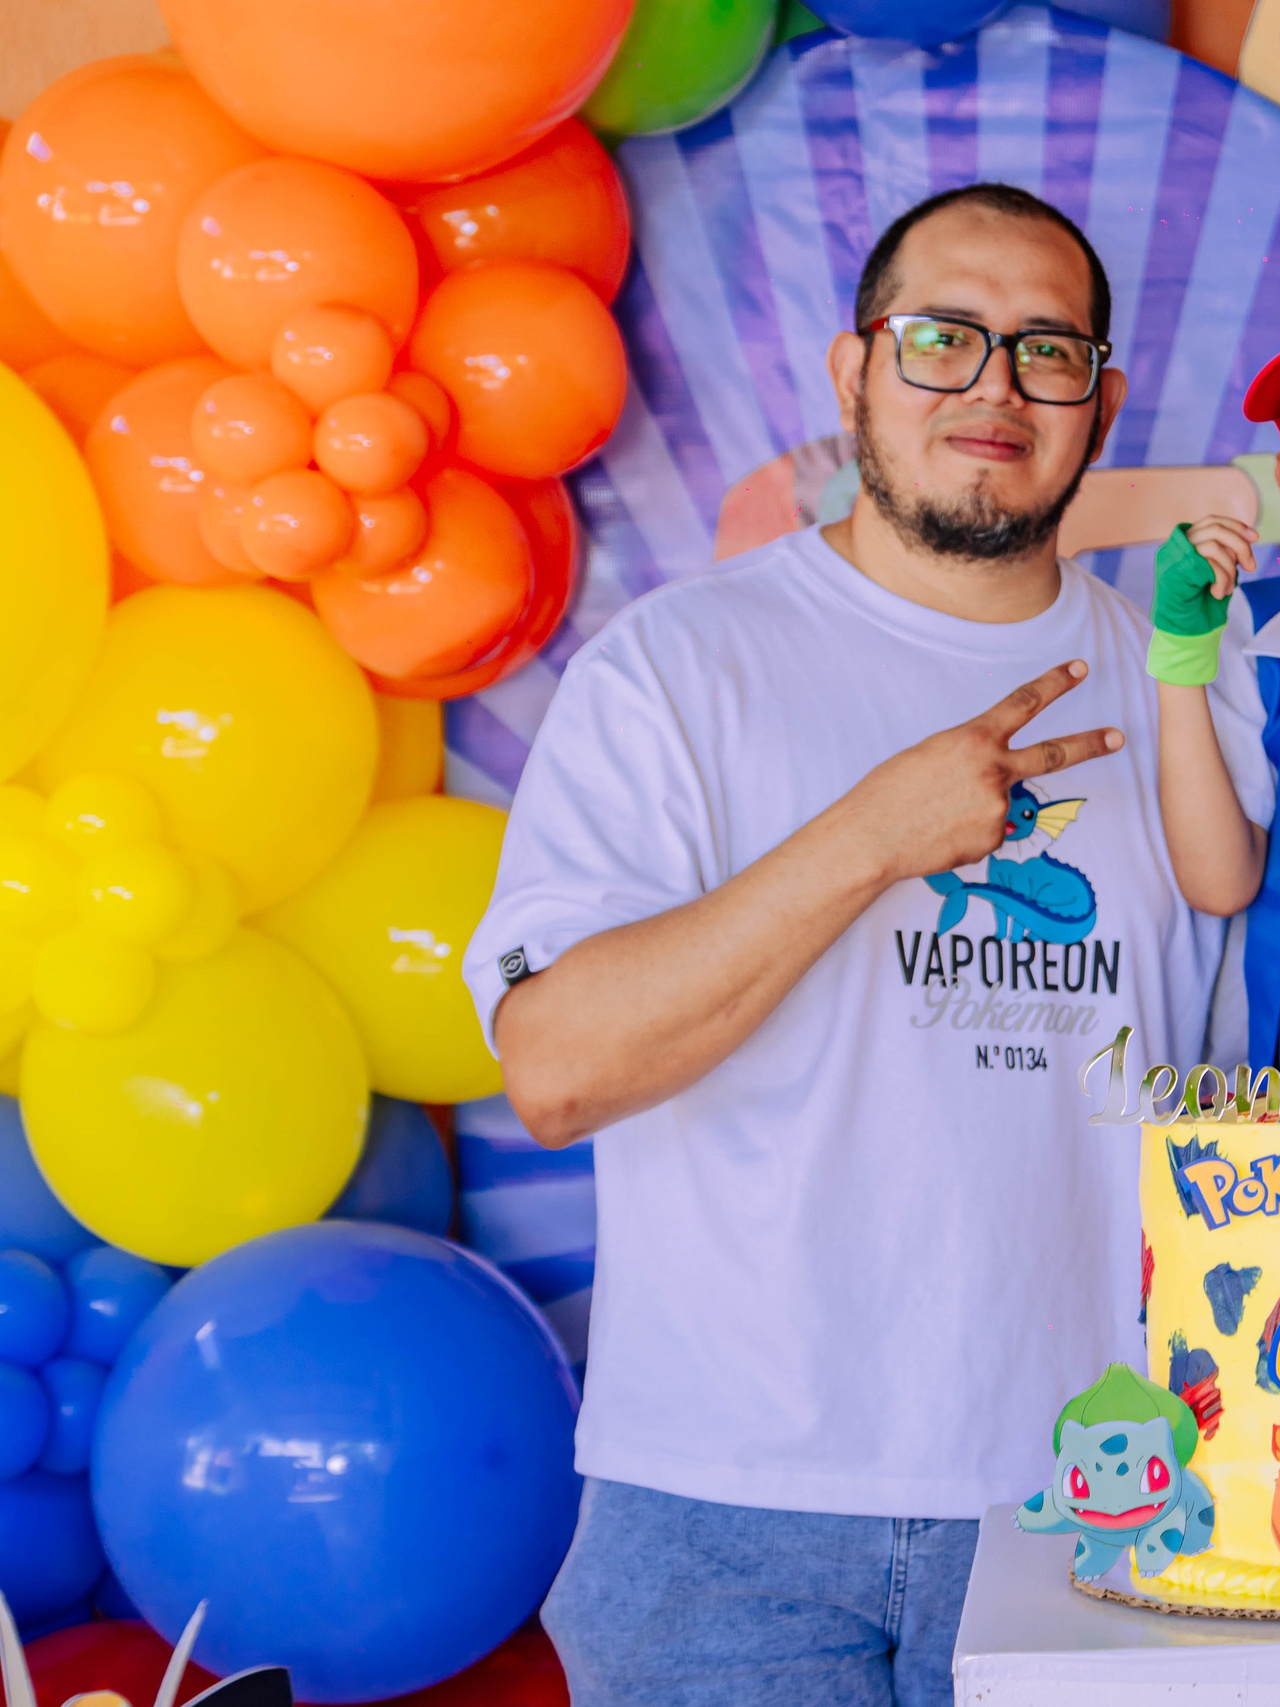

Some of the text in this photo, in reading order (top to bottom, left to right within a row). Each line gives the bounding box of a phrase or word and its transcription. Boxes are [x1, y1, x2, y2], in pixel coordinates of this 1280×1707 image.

[894, 929, 1121, 995] VAPOREON
[909, 973, 1102, 1037] Pokémon
[1005, 1046, 1048, 1071] 0134
